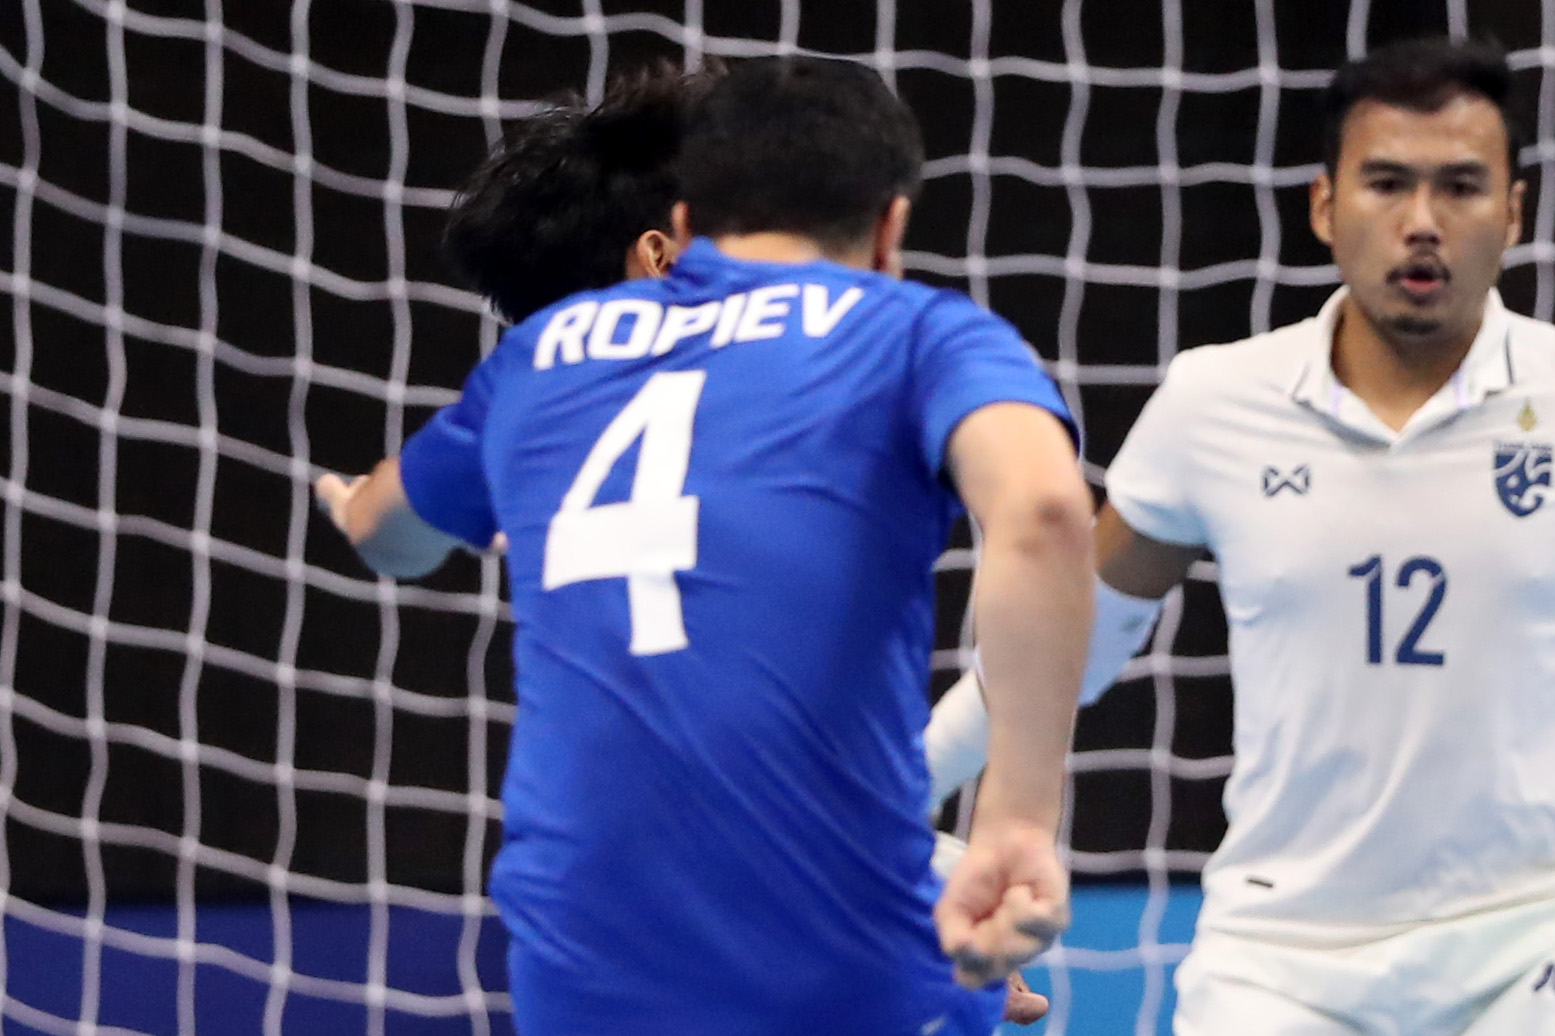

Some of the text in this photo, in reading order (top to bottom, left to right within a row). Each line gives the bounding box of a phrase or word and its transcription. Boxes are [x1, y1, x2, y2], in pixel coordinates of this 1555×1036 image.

[534, 283, 864, 371] ROPIEV
[541, 369, 707, 656] 4
[1347, 554, 1448, 666] 12
